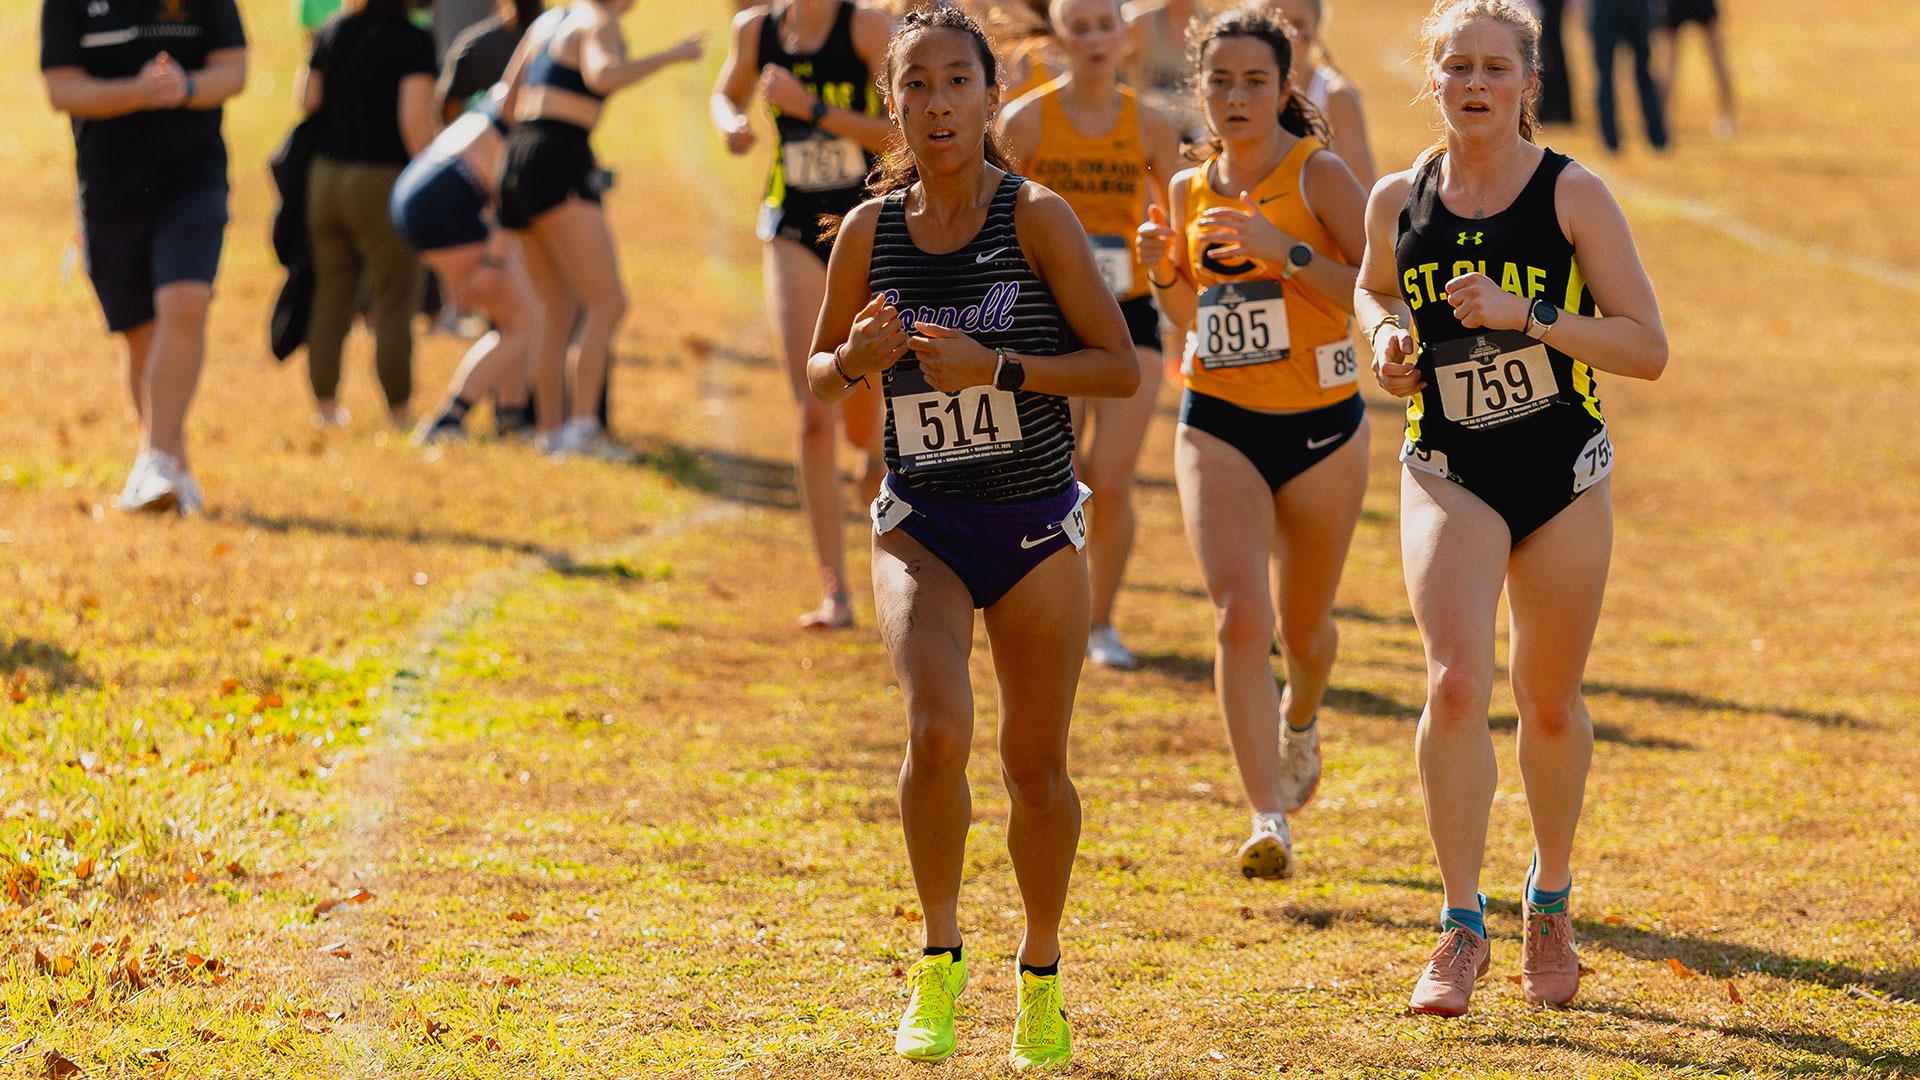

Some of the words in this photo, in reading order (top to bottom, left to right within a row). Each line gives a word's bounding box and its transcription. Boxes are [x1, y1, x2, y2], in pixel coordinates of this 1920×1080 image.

[1403, 262, 1447, 311] ST.
[1207, 309, 1270, 354] 895
[1455, 359, 1533, 418] 759
[918, 393, 999, 451] 514
